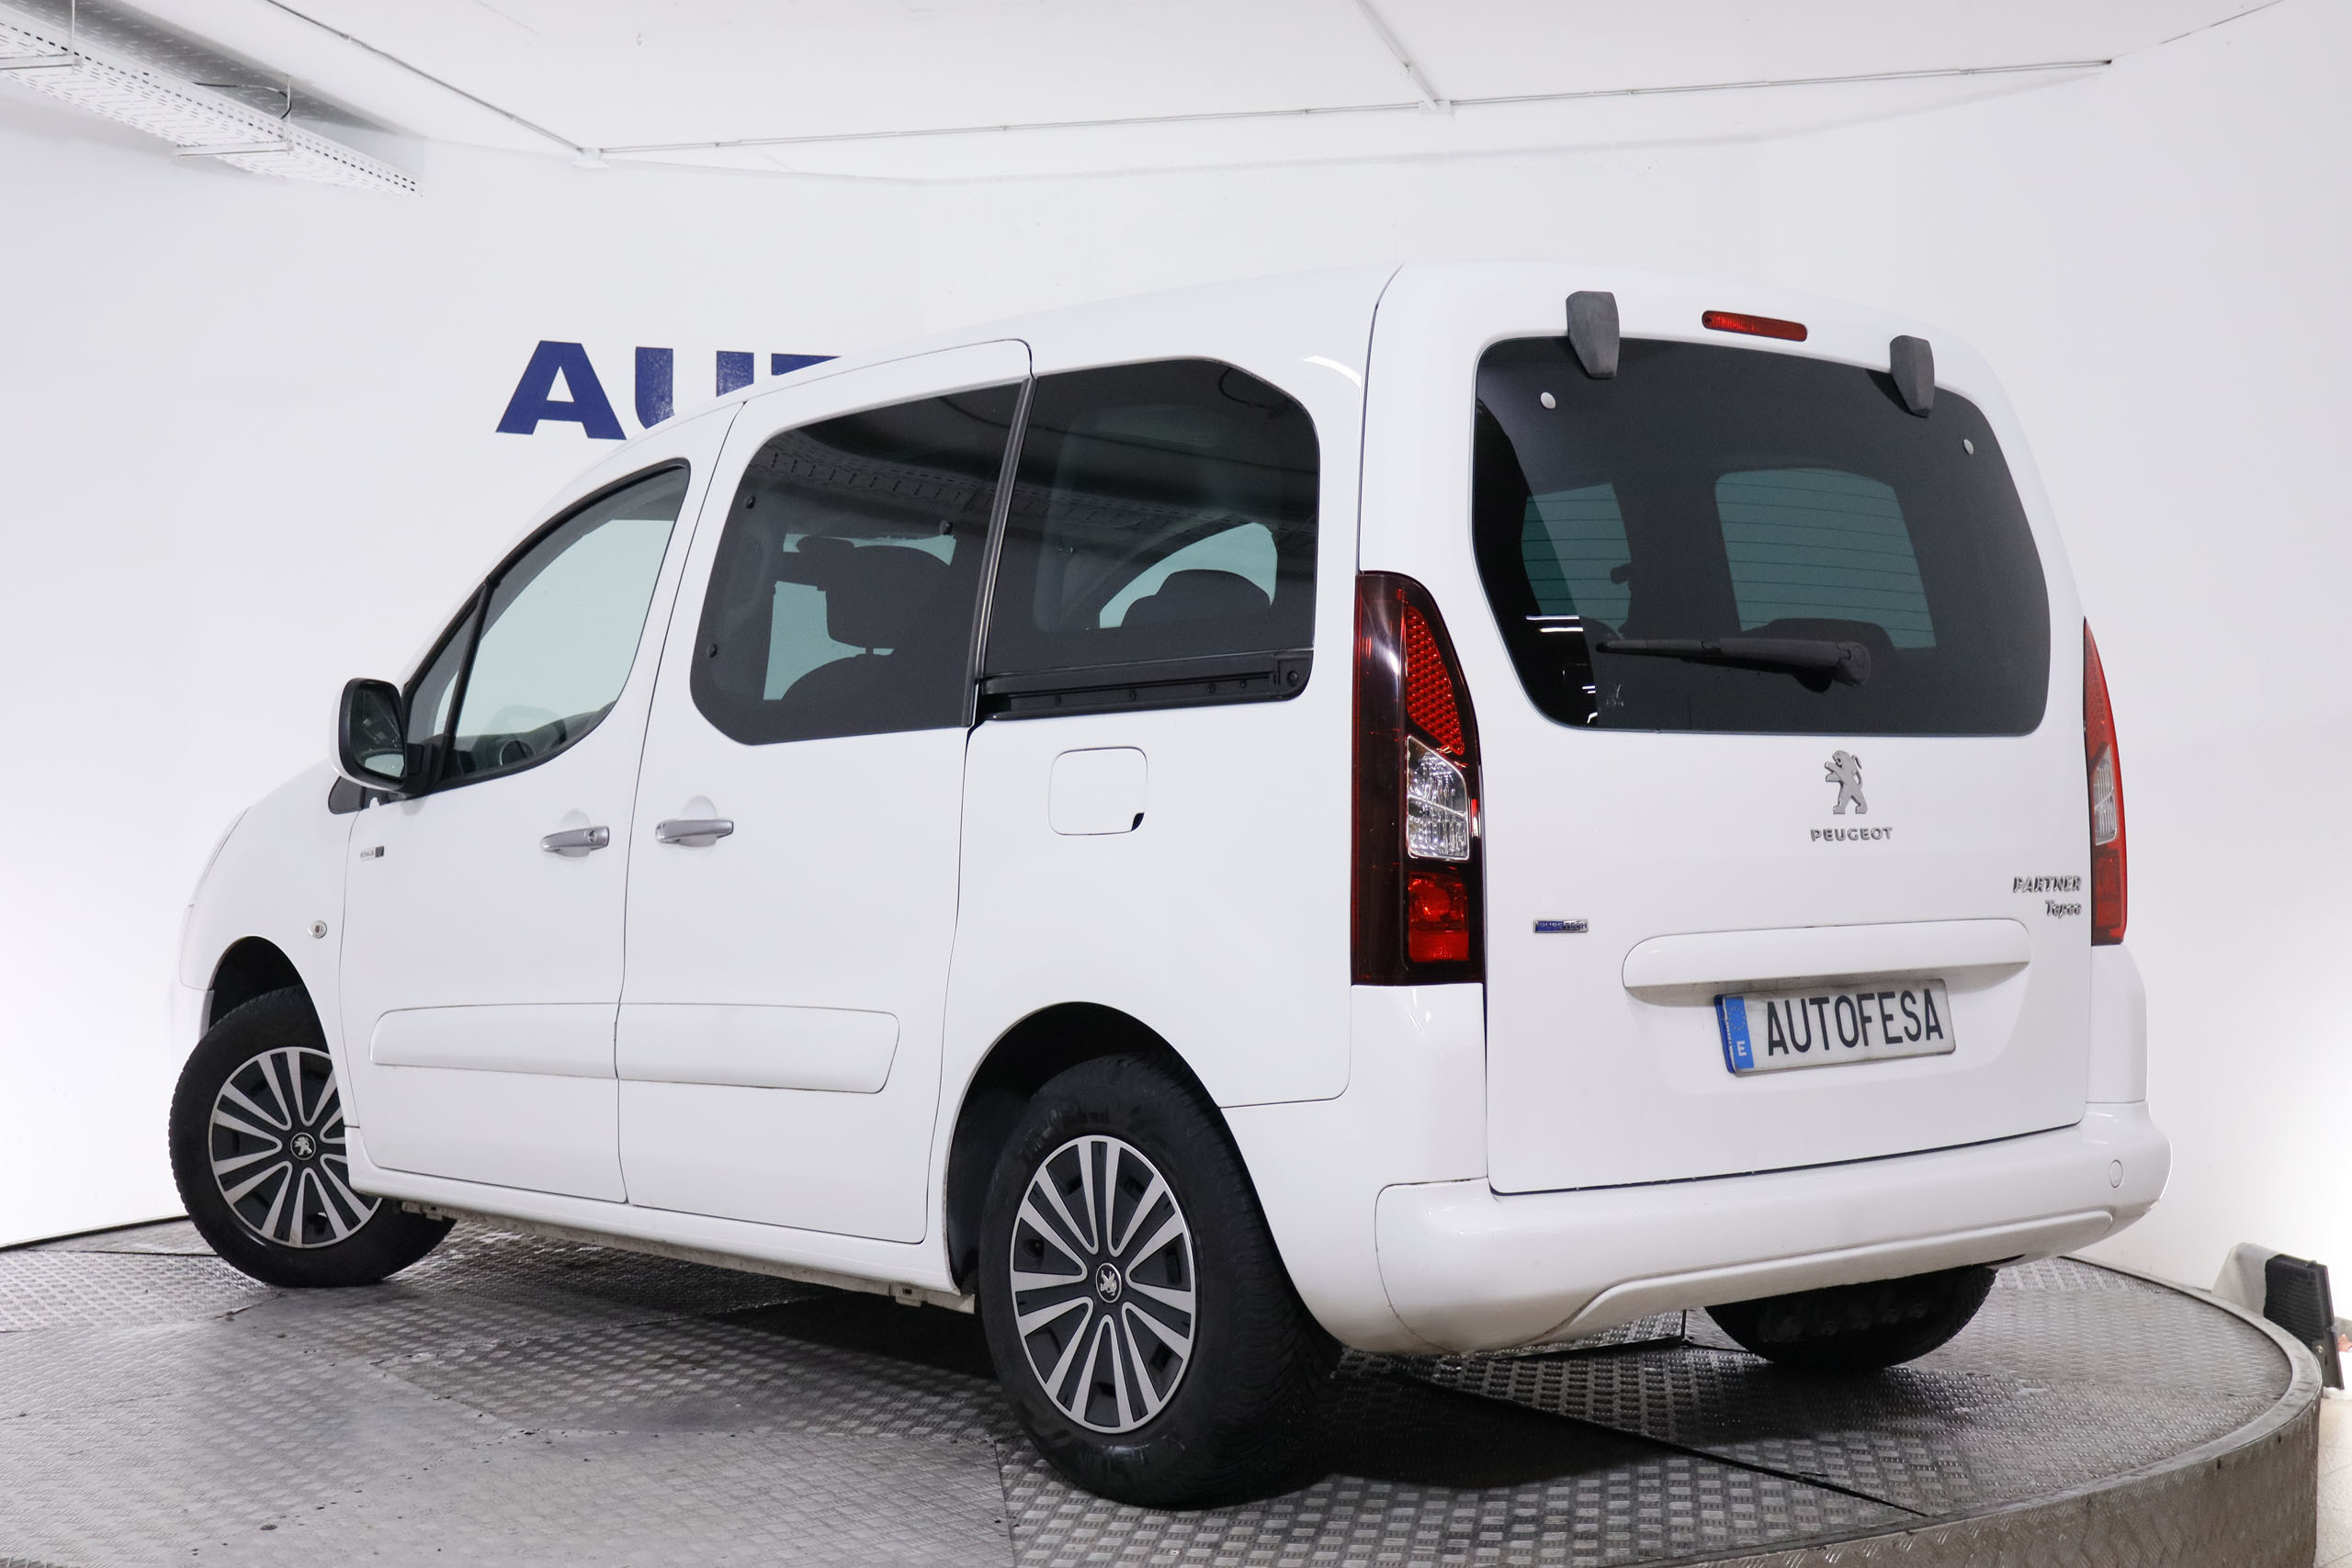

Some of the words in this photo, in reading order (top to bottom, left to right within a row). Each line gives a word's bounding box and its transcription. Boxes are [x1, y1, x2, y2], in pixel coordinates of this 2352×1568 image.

[495, 340, 842, 440] AU
[1810, 827, 1893, 842] PEUGEOT
[2012, 875, 2082, 894] PARTNER
[1767, 988, 1944, 1056] AUTOFESA
[1736, 1040, 1747, 1056] E
